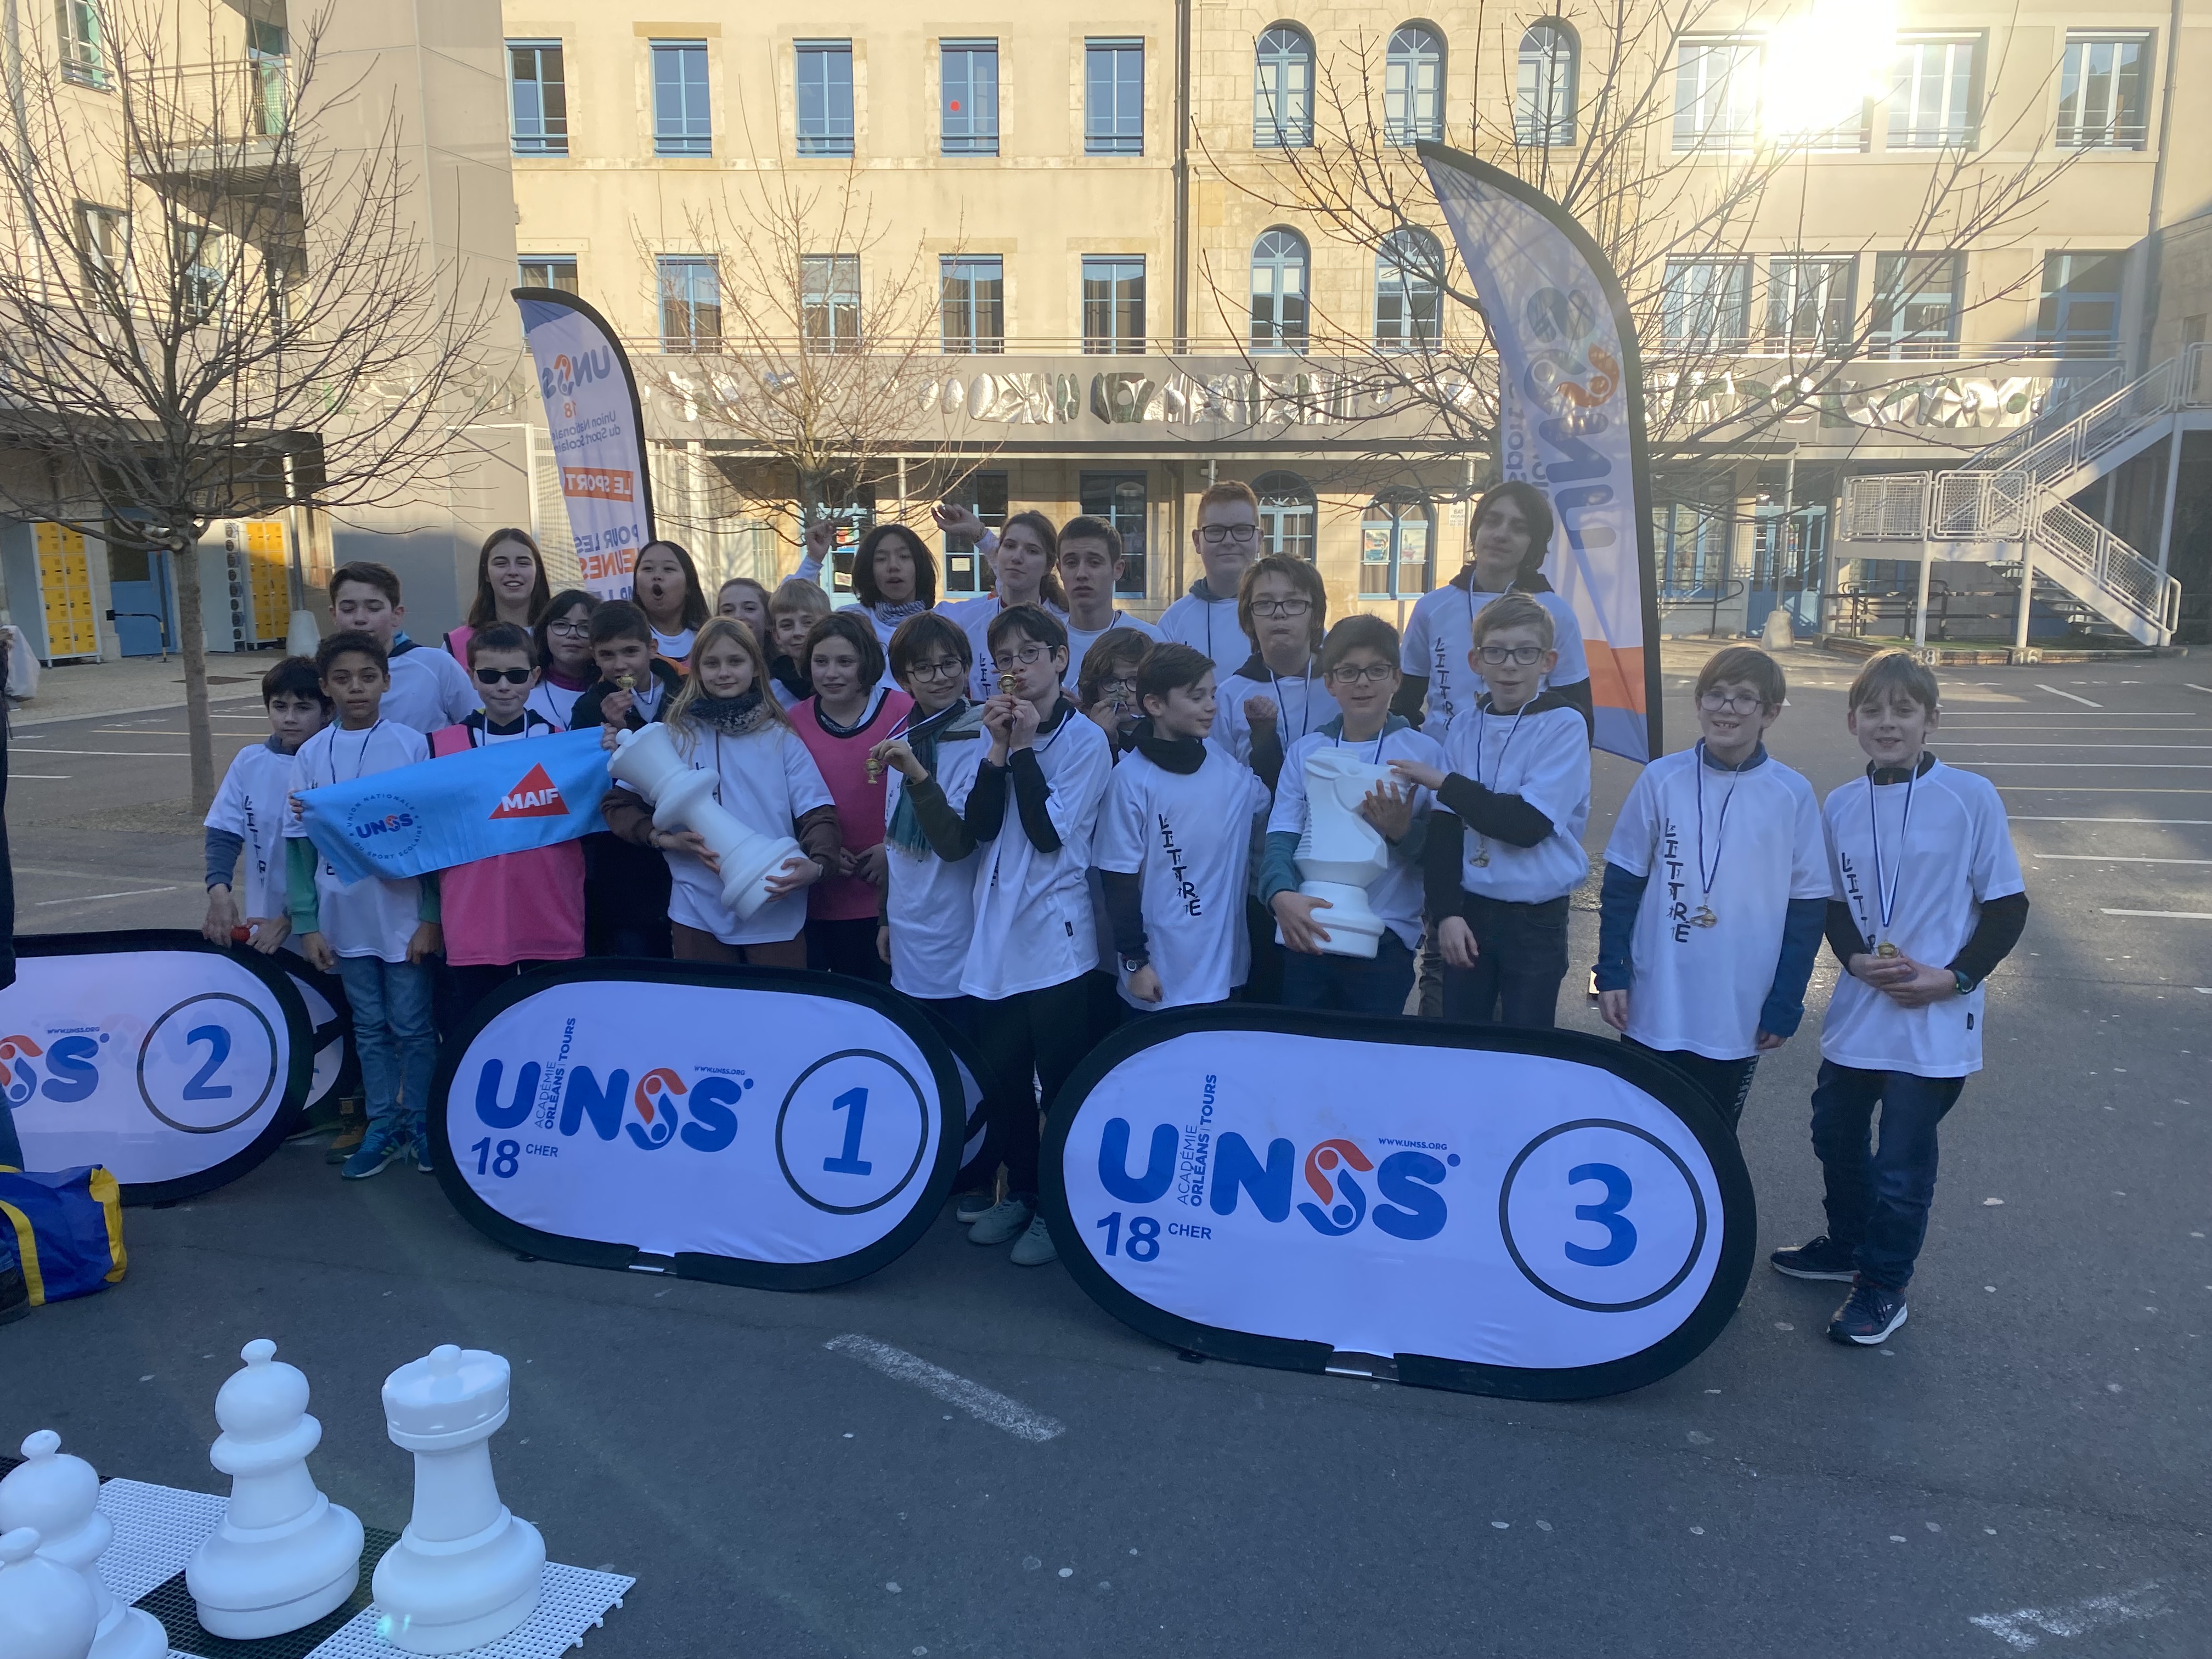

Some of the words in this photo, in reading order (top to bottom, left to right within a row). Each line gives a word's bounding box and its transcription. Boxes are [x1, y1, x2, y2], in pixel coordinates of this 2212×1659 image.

[2014, 650, 2038, 664] 16
[347, 803, 362, 827] UNION
[364, 794, 415, 810] NATIONALE
[501, 788, 558, 811] MAIF
[354, 842, 364, 851] DU
[368, 851, 394, 859] SPORT
[398, 826, 422, 857] SCOLAIRE
[356, 814, 413, 839] UNSS
[183, 1025, 233, 1101] 2
[558, 1018, 575, 1062] TOURS
[694, 1065, 746, 1076] WWW.UNSS.ORG
[475, 1058, 742, 1152] UNSS
[534, 1061, 556, 1128] ACADÉMIE
[823, 1087, 872, 1176] 1
[1190, 1132, 1210, 1207] ORLÉANS
[1200, 1074, 1217, 1125] TOURS
[1379, 1138, 1448, 1150] WWW.UNSS.ORG
[471, 1137, 520, 1178] 18
[526, 1144, 558, 1158] CHER
[1098, 1117, 1448, 1240] UNSS
[1177, 1125, 1198, 1206] ACADÉMIE
[1097, 1211, 1161, 1262] 18
[1168, 1223, 1211, 1240] CHER
[1565, 1163, 1638, 1267] 3
